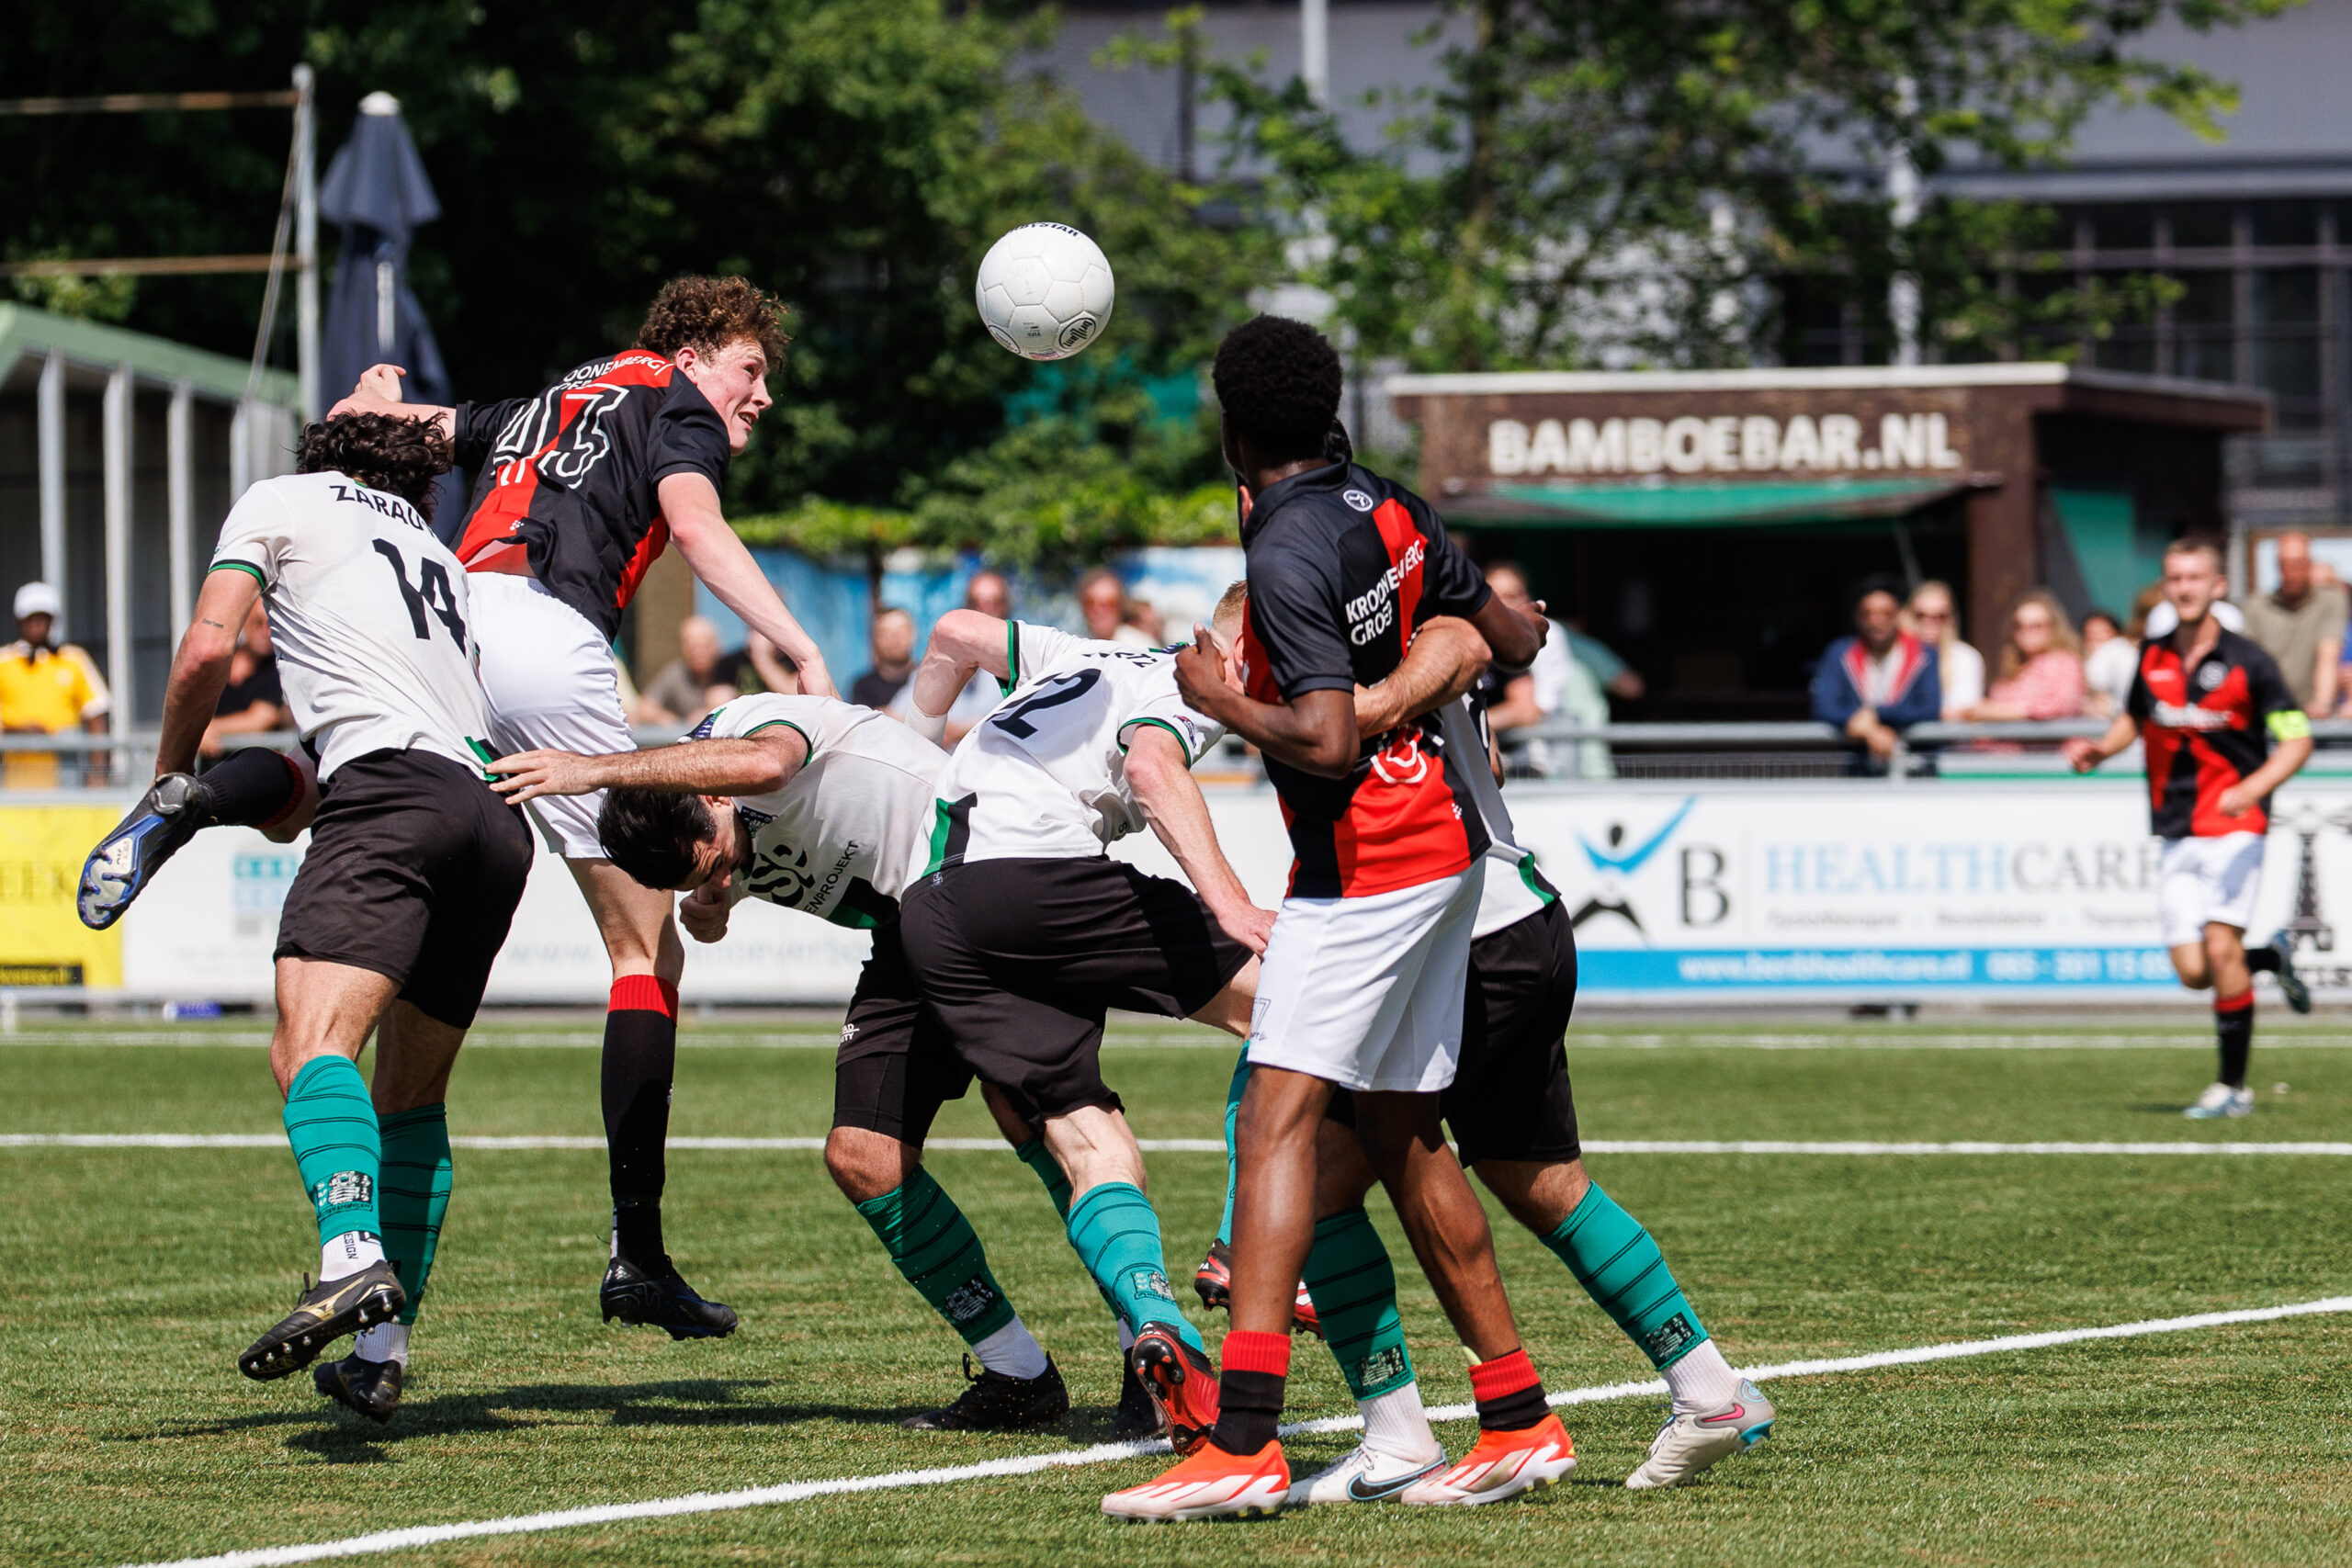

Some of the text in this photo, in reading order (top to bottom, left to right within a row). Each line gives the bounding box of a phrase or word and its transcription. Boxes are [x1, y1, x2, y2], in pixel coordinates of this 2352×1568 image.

[1488, 413, 1963, 475] BAMBOEBAR.NL
[329, 485, 436, 538] ZARAU
[371, 537, 468, 660] 14
